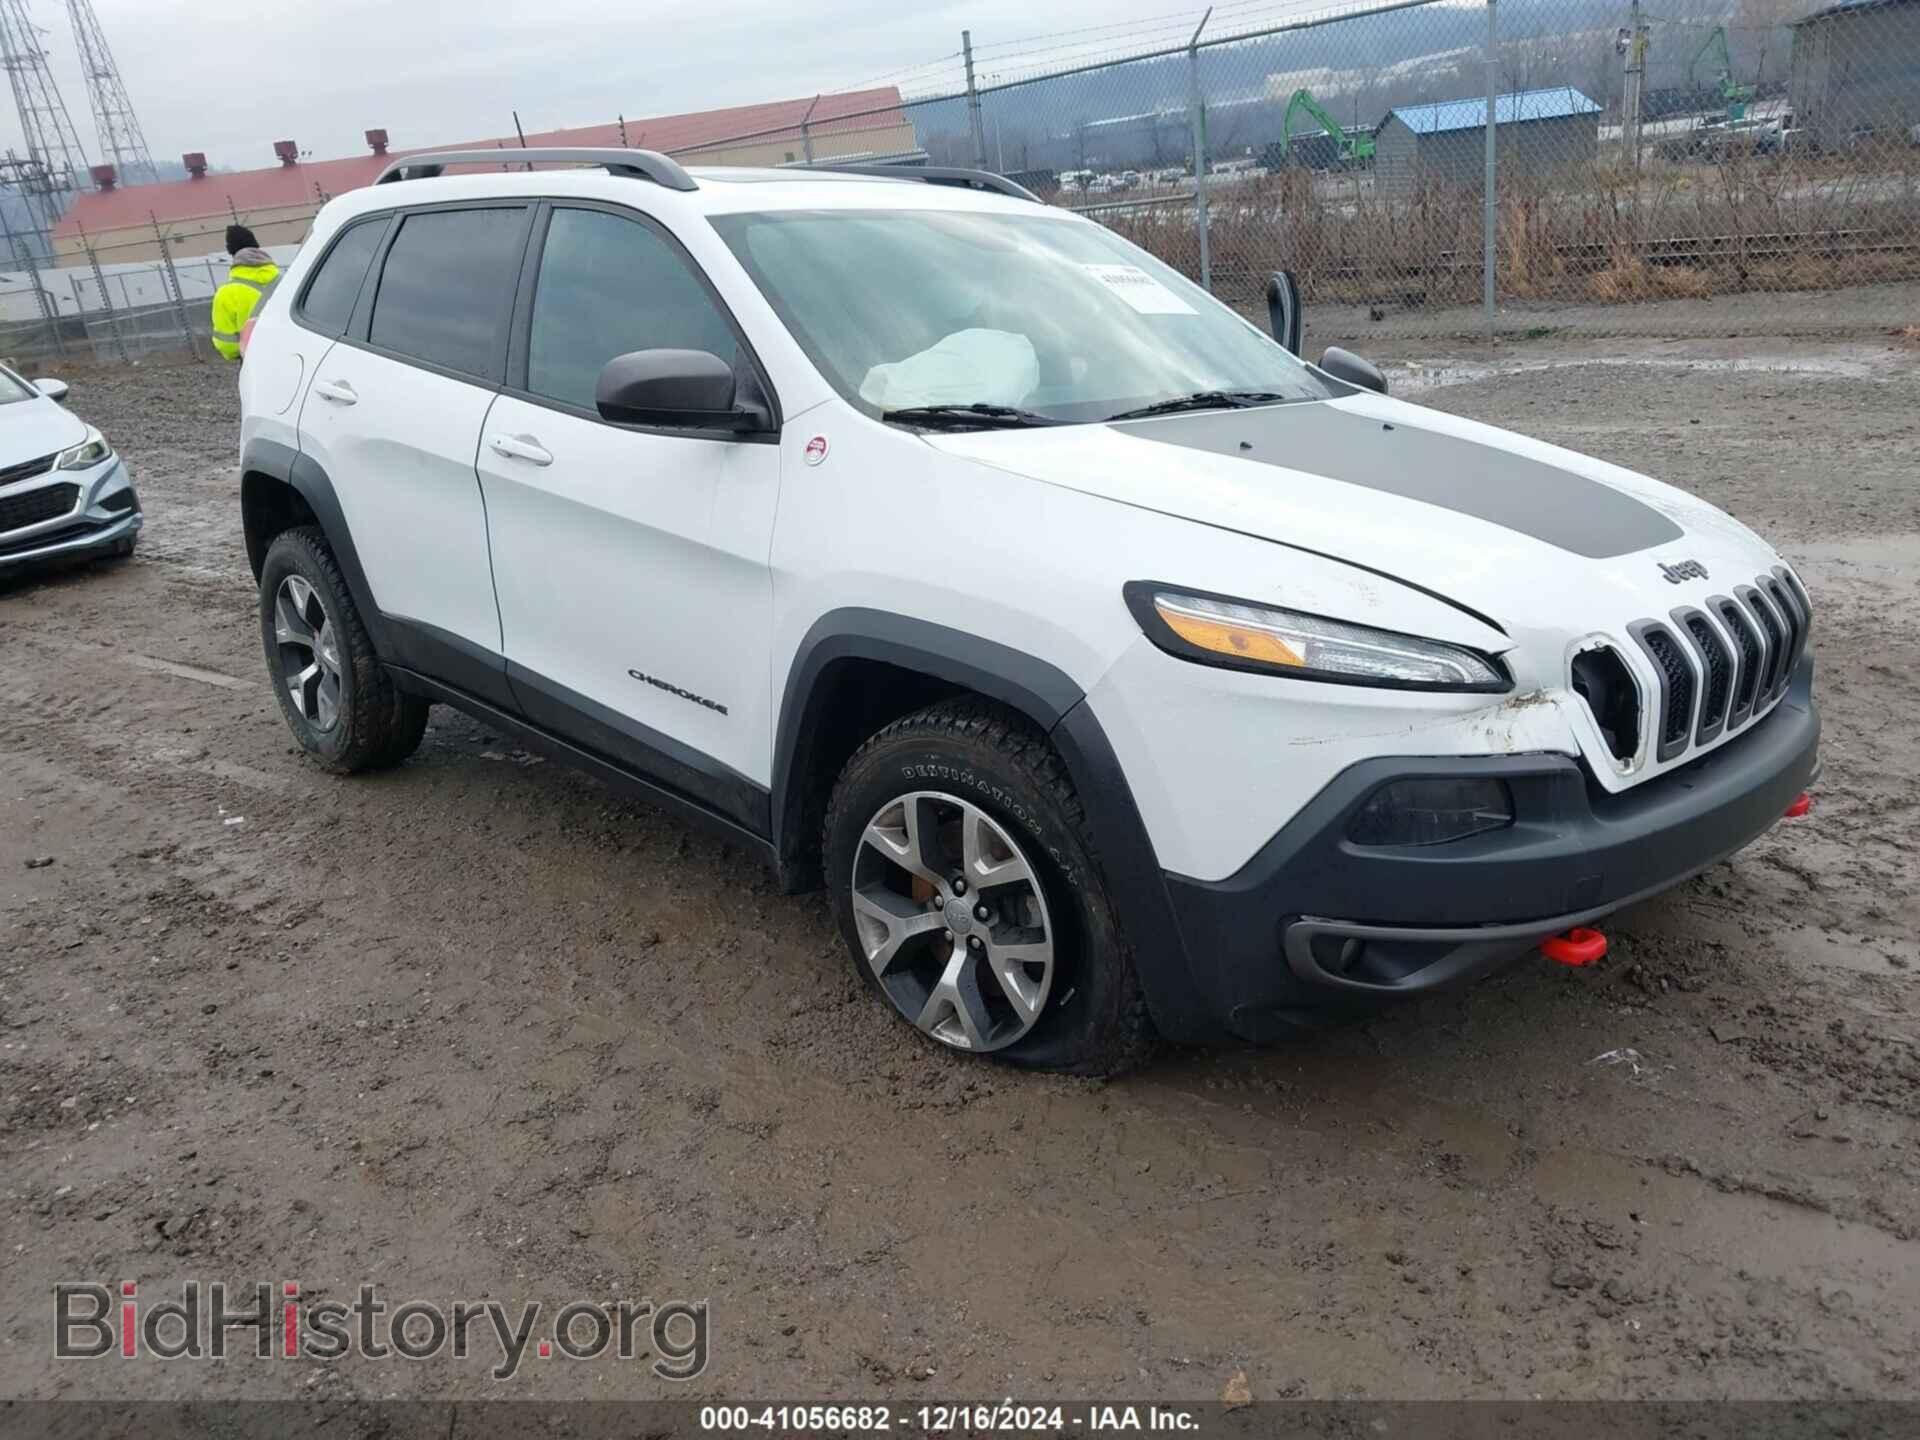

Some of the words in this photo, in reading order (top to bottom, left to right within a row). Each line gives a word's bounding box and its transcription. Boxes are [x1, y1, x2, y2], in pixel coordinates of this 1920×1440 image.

[1657, 559, 1709, 584] Jeep
[628, 669, 729, 716] CHEROKEE
[901, 764, 1043, 834] DESTINATION
